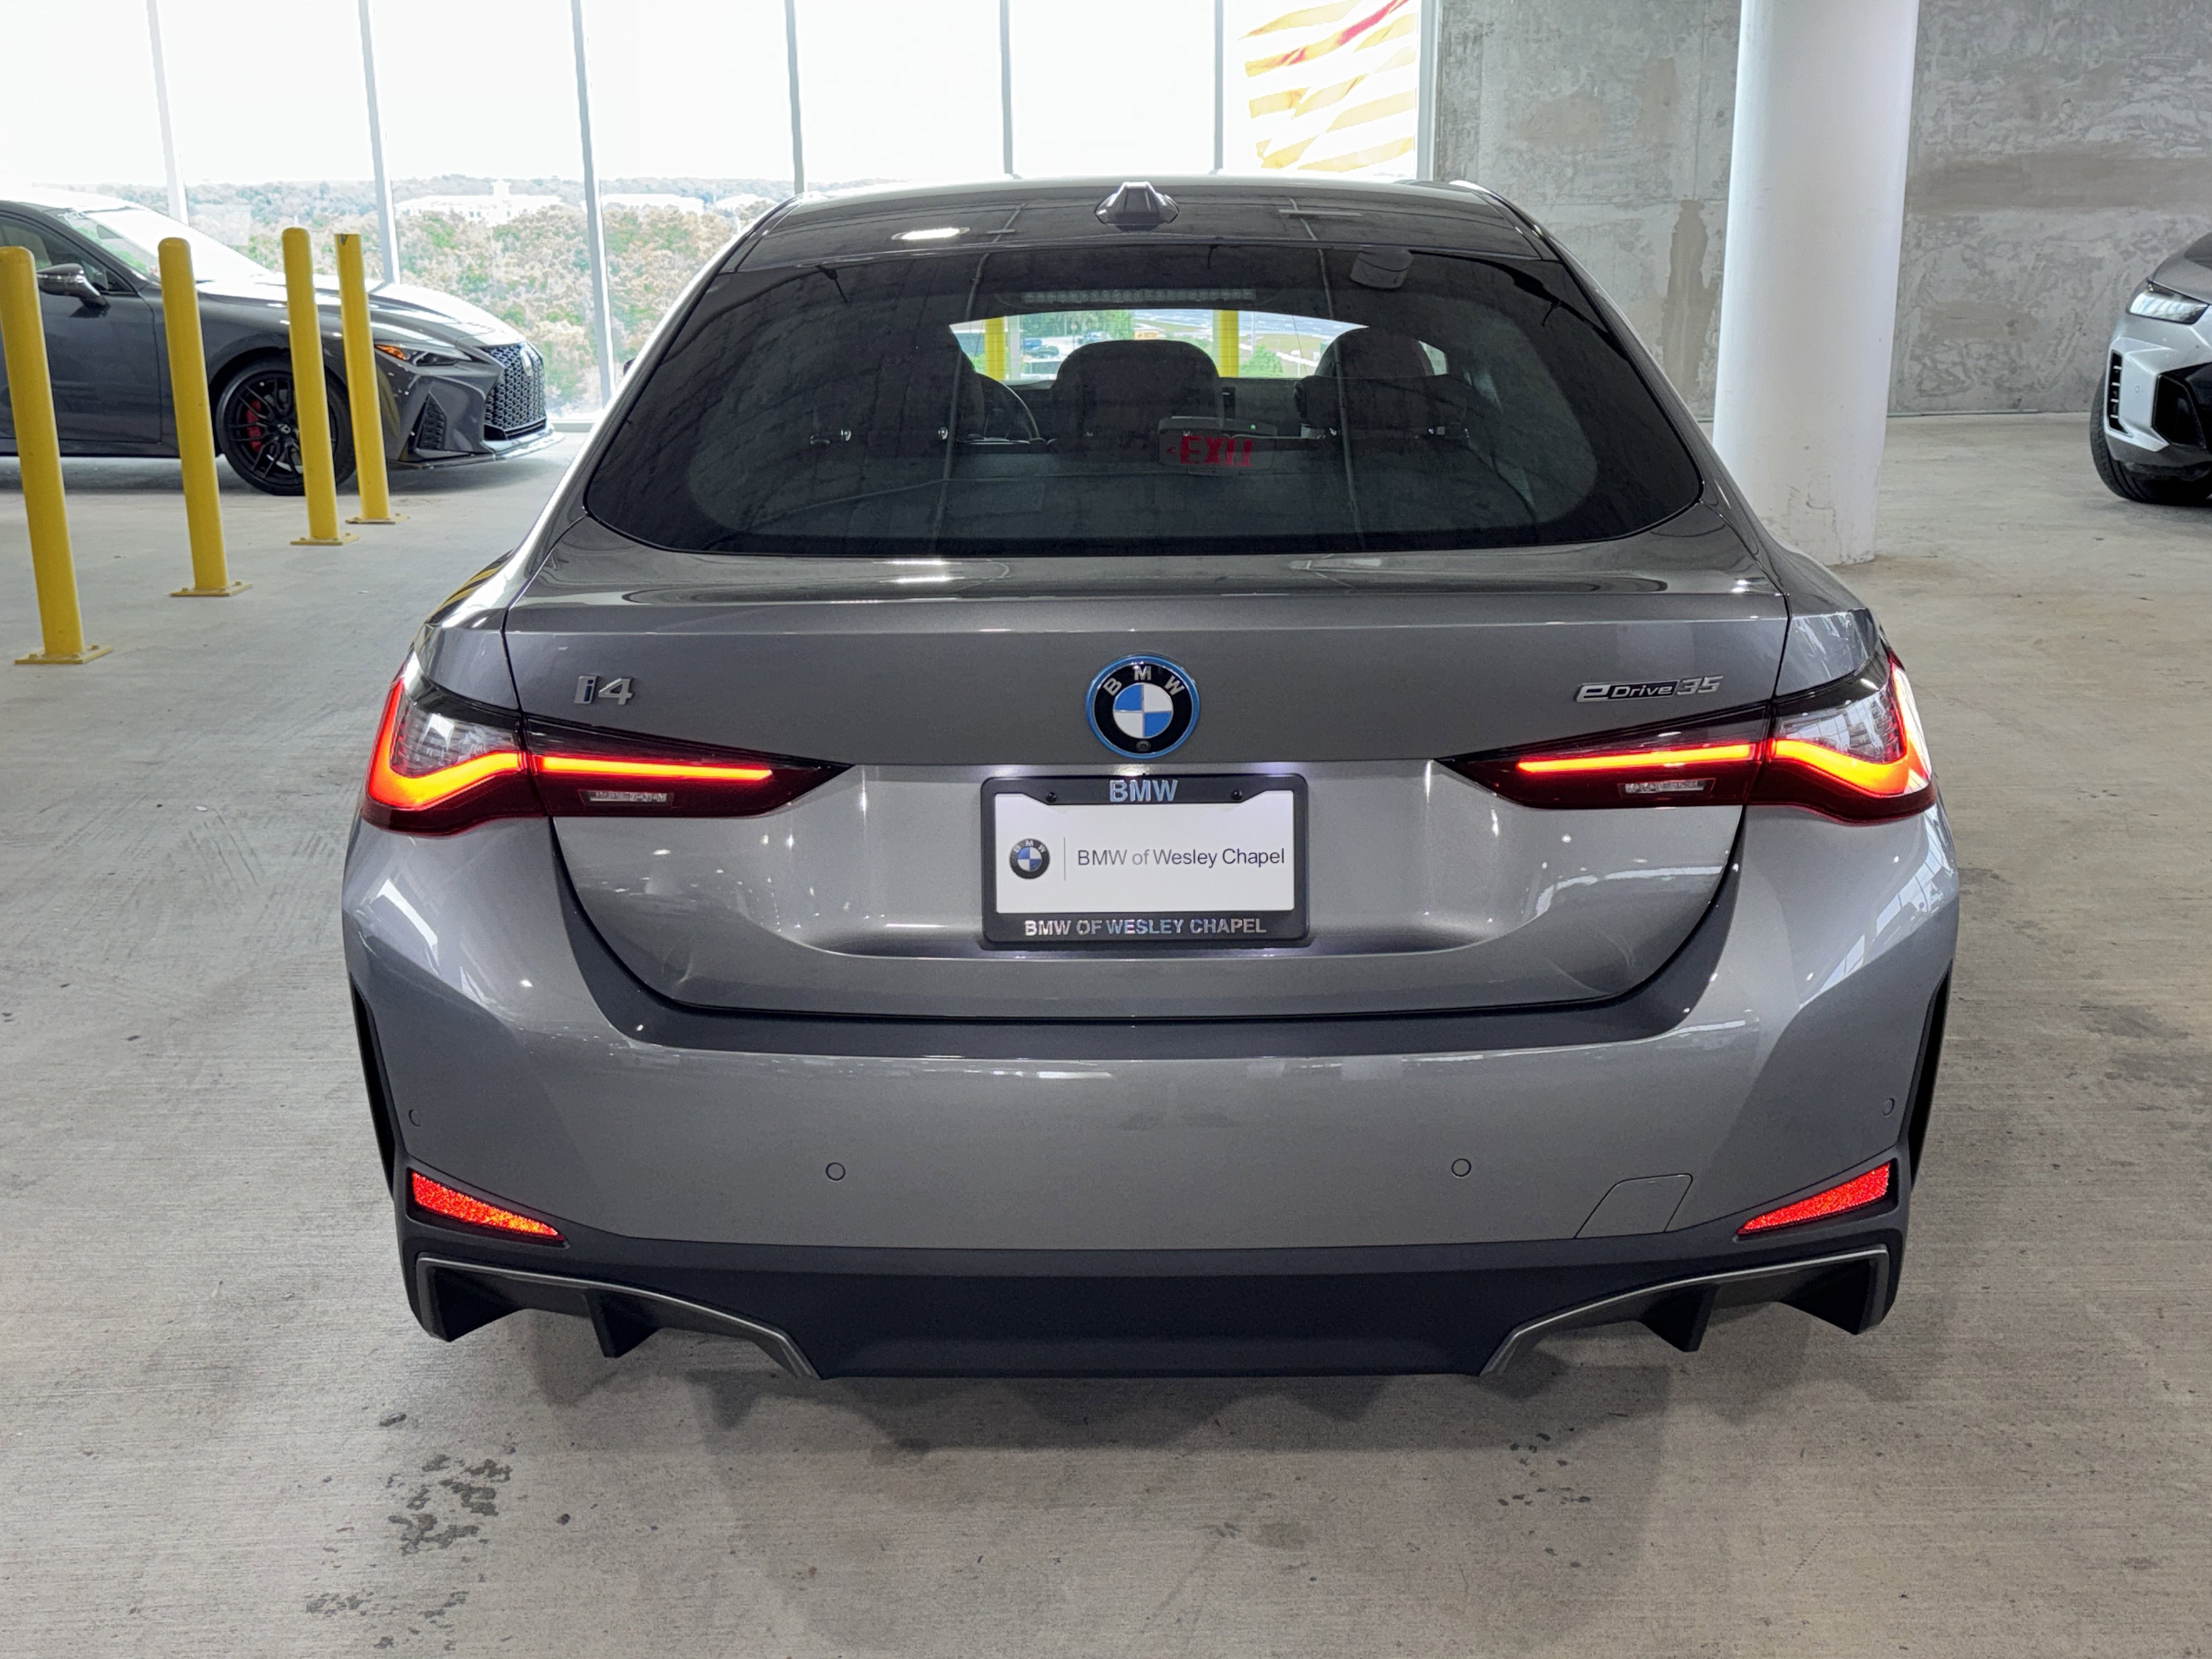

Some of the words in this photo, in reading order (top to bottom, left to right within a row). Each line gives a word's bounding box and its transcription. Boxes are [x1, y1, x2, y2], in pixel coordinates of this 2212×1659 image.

[574, 675, 634, 705] i4
[1103, 665, 1185, 696] BMW
[1109, 779, 1178, 802] BMW
[1013, 839, 1047, 853] BMW
[1078, 850, 1127, 866] BMW
[1132, 849, 1150, 865] of
[1153, 849, 1217, 868] Wesley
[1222, 848, 1285, 867] Chapel
[1025, 920, 1071, 936] BMW
[1076, 919, 1102, 935] OF
[1106, 919, 1184, 934] WESLEY
[1189, 918, 1267, 933] CHAPEL
